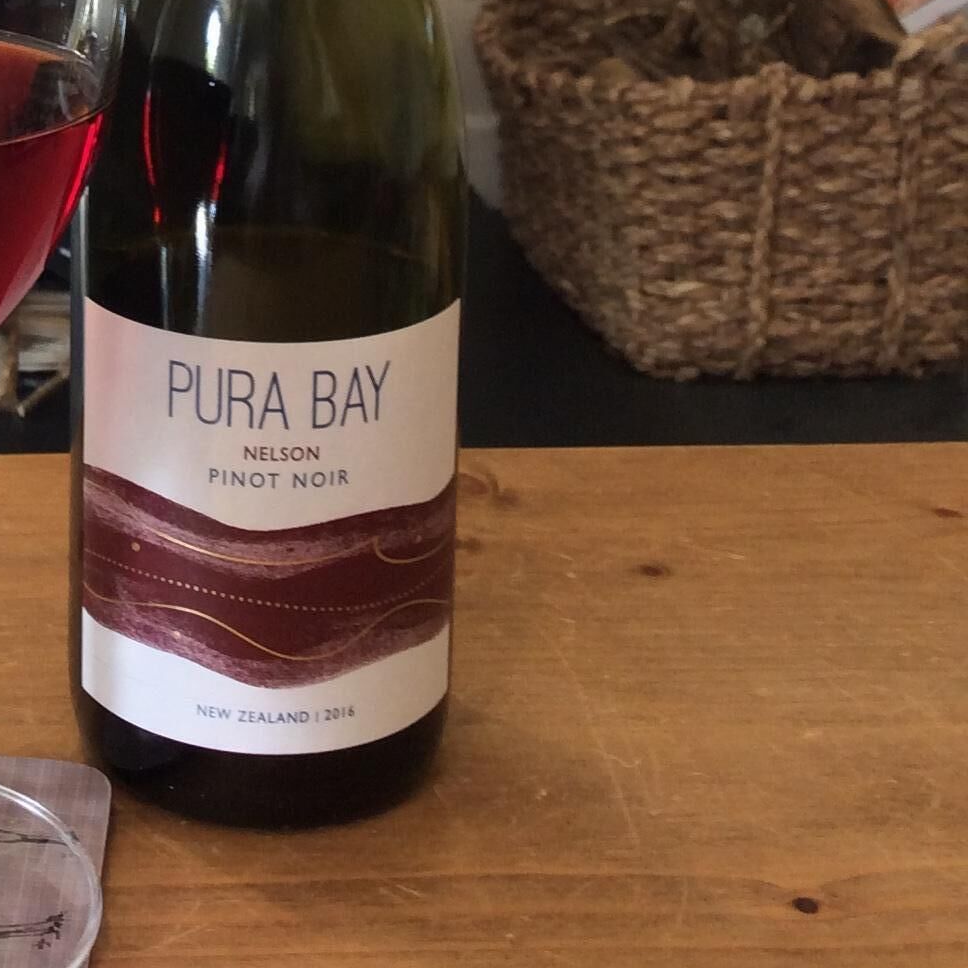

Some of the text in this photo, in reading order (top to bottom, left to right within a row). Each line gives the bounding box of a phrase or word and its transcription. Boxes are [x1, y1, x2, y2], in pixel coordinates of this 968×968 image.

[169, 360, 390, 430] PURA BAY
[244, 446, 320, 462] NELSON
[209, 468, 348, 488] PINOT NOIR
[197, 704, 231, 719] NEW
[238, 710, 310, 724] ZEALAND
[324, 706, 355, 721] 2016
